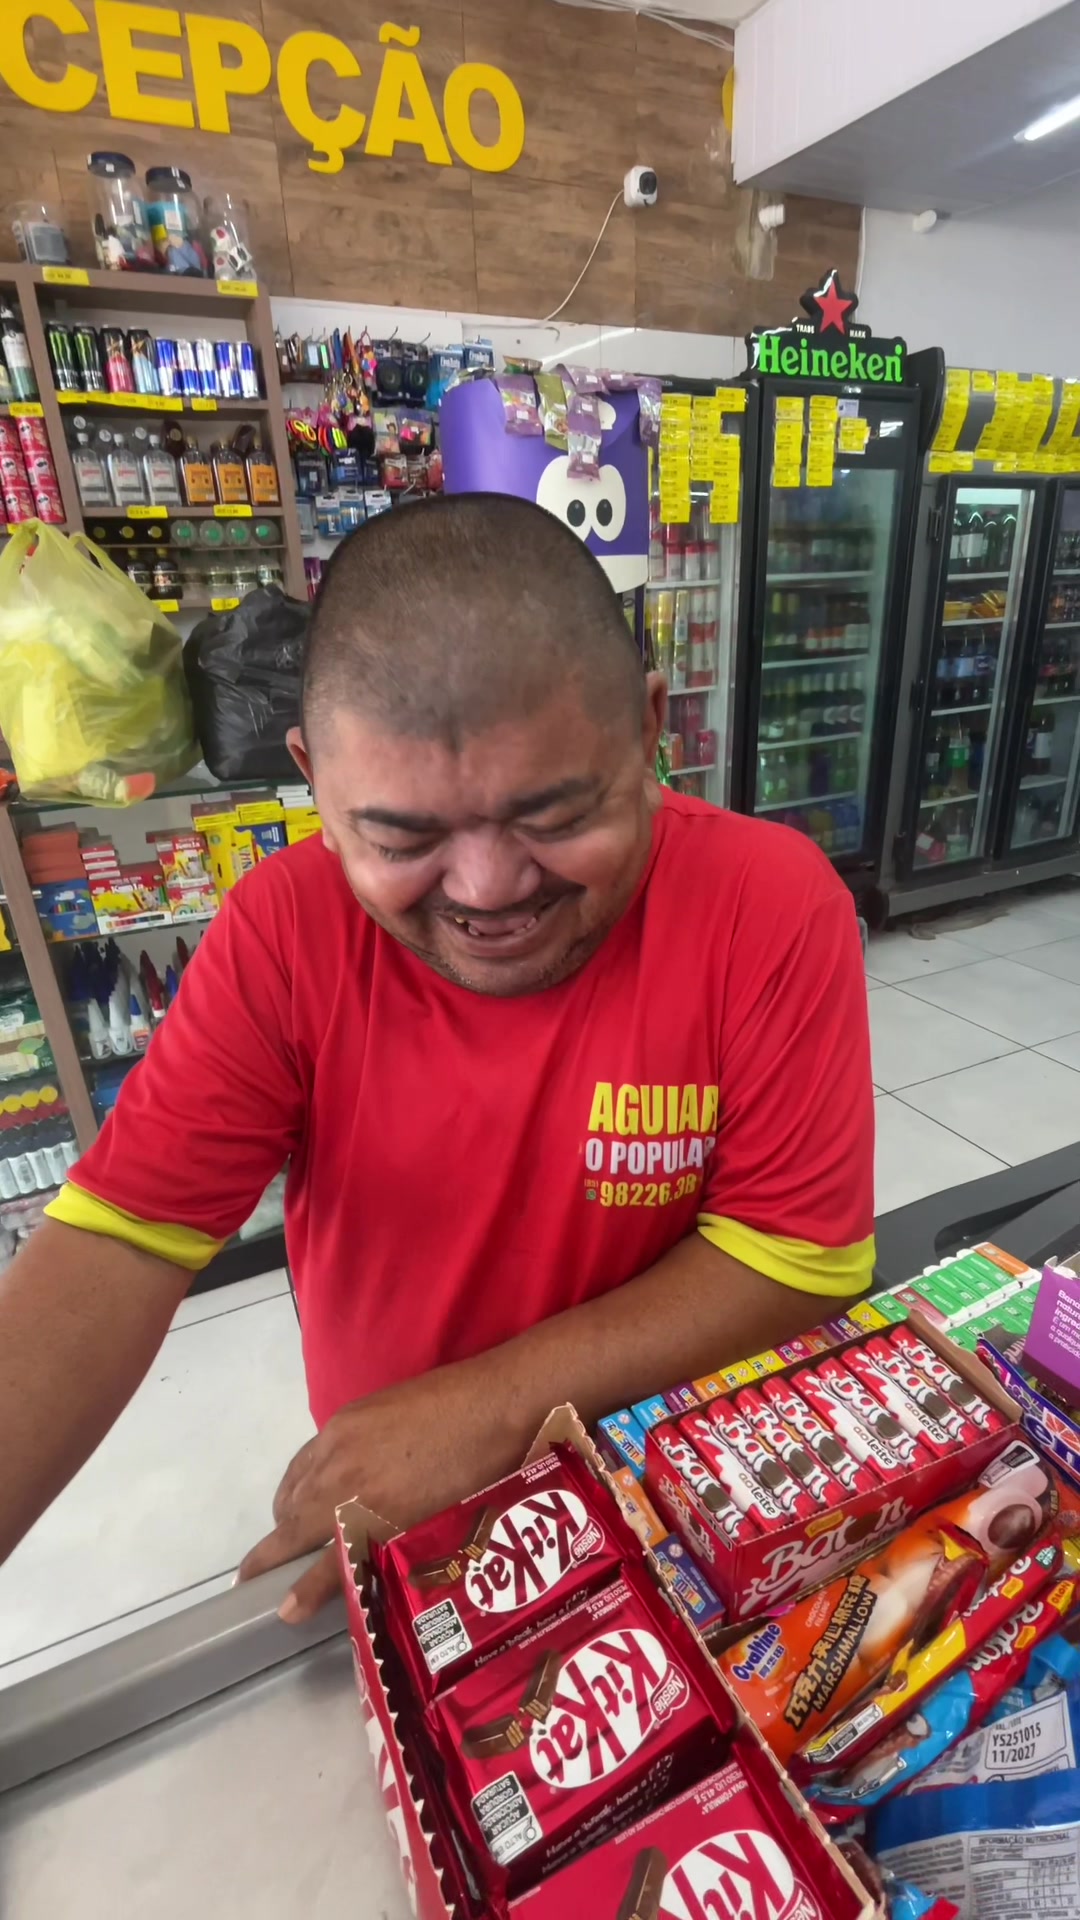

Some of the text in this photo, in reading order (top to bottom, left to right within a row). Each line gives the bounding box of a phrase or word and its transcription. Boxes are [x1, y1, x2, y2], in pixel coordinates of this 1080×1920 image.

[0, 0, 525, 173] CEPÇÃO
[757, 335, 903, 382] Heineken
[849, 330, 866, 338] MARK
[585, 1138, 604, 1171] O
[881, 1350, 966, 1442] Baton
[903, 1339, 991, 1429] Baton
[776, 1392, 860, 1489] Baton
[830, 1370, 917, 1464] Baton
[904, 1401, 944, 1441] ao leite
[720, 1413, 801, 1513] Baton
[747, 1403, 829, 1503] Baton
[853, 1425, 893, 1466] ao leite
[664, 1438, 744, 1537] Baton
[739, 1472, 777, 1516] ao leite
[469, 1492, 580, 1610] KitKat
[758, 1496, 912, 1592] Baton
[732, 1623, 781, 1681] Ovaltine
[813, 1594, 874, 1710] MARSHMALLOW
[536, 1631, 661, 1784] KitKat
[655, 1675, 685, 1716] Nestlé
[992, 1722, 1042, 1747] YS251015
[992, 1743, 1036, 1763] 11/2027
[475, 1778, 511, 1806] SATURADA
[479, 1788, 514, 1815] GORDURA
[699, 1787, 715, 1801] 41,5
[505, 1833, 523, 1849] ALTO
